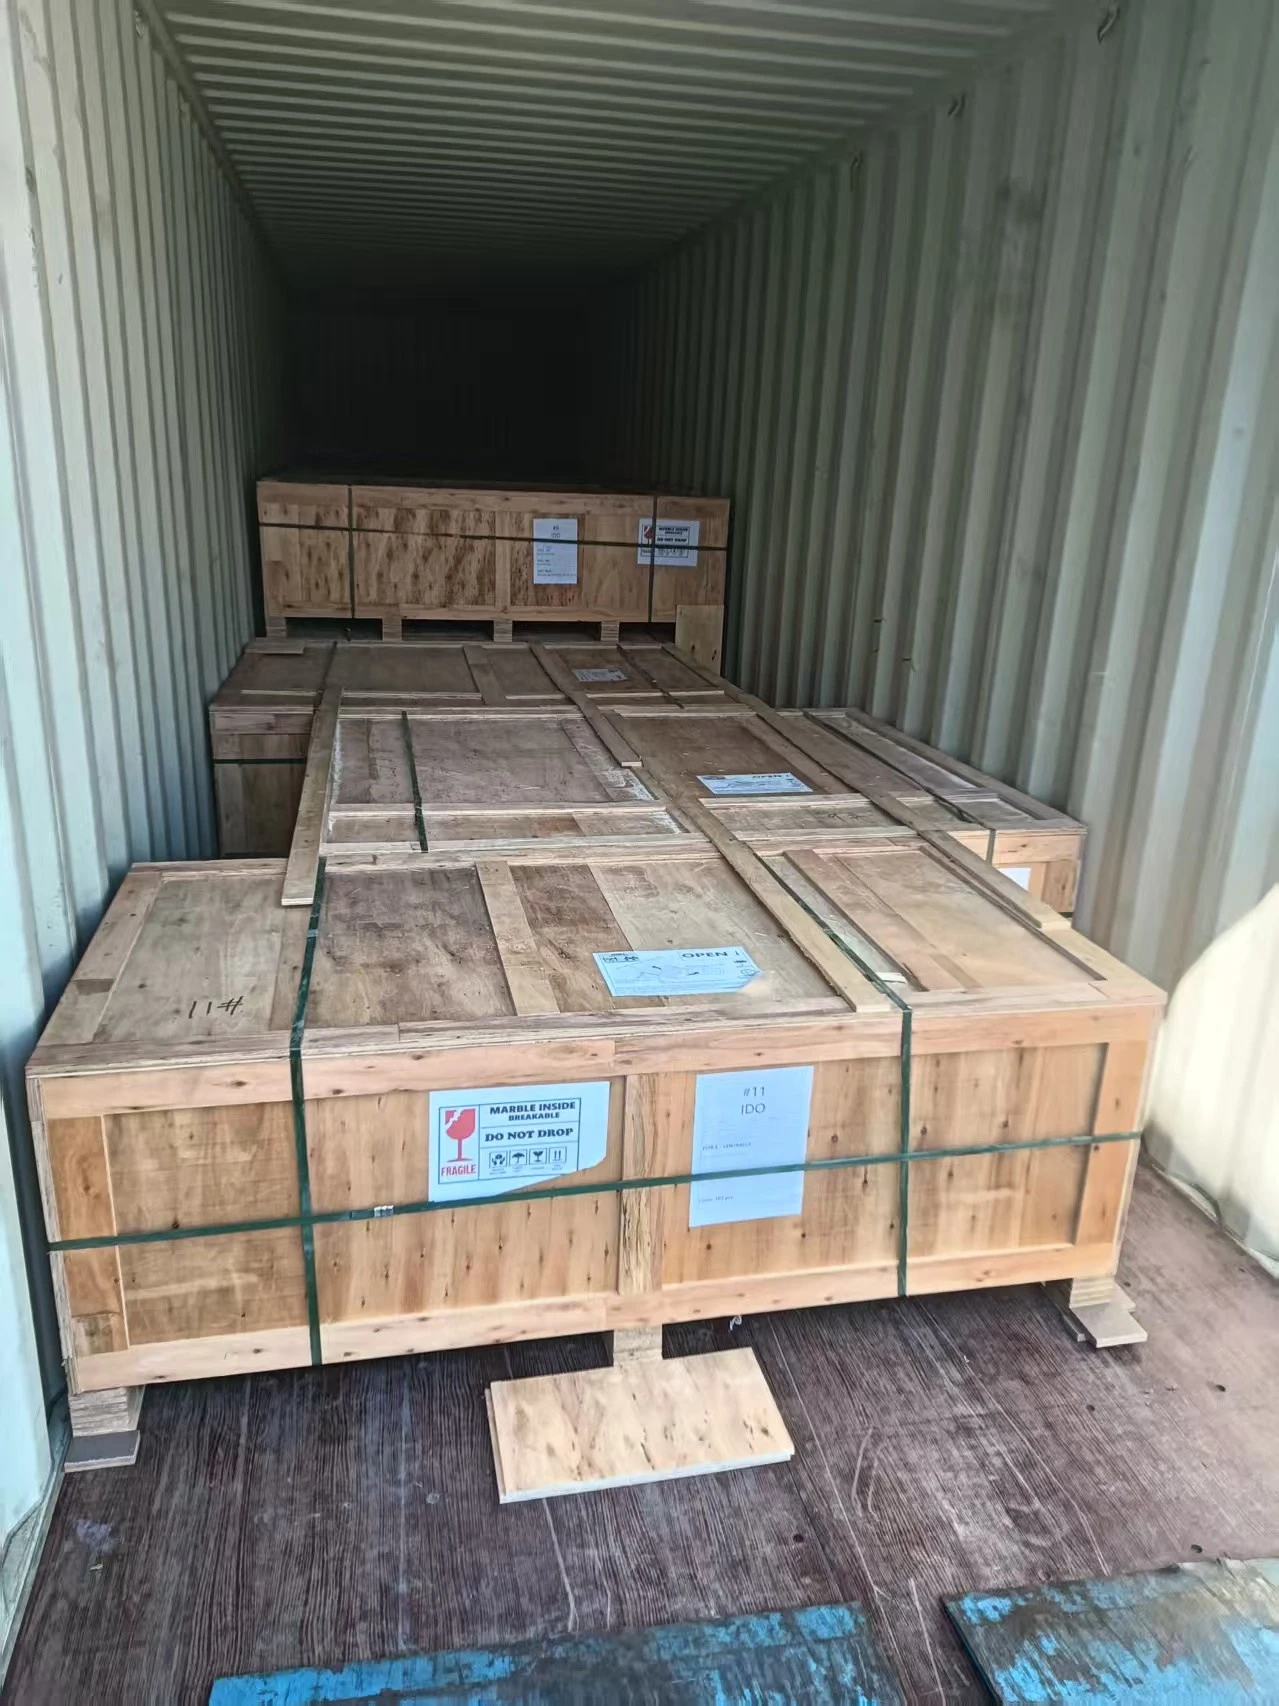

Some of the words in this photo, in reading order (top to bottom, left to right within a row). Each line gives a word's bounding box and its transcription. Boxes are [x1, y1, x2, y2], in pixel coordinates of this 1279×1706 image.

[682, 950, 728, 958] OPEN
[743, 1086, 765, 1097] #11
[489, 1104, 536, 1115] MARBLE
[538, 1101, 576, 1111] INSIDE
[740, 1102, 766, 1115] IDO
[508, 1111, 560, 1121] BREAKABLE
[484, 1132, 504, 1142] DO
[507, 1130, 535, 1141] NOT
[537, 1127, 574, 1138] DROP
[440, 1163, 477, 1177] FRAGILE
